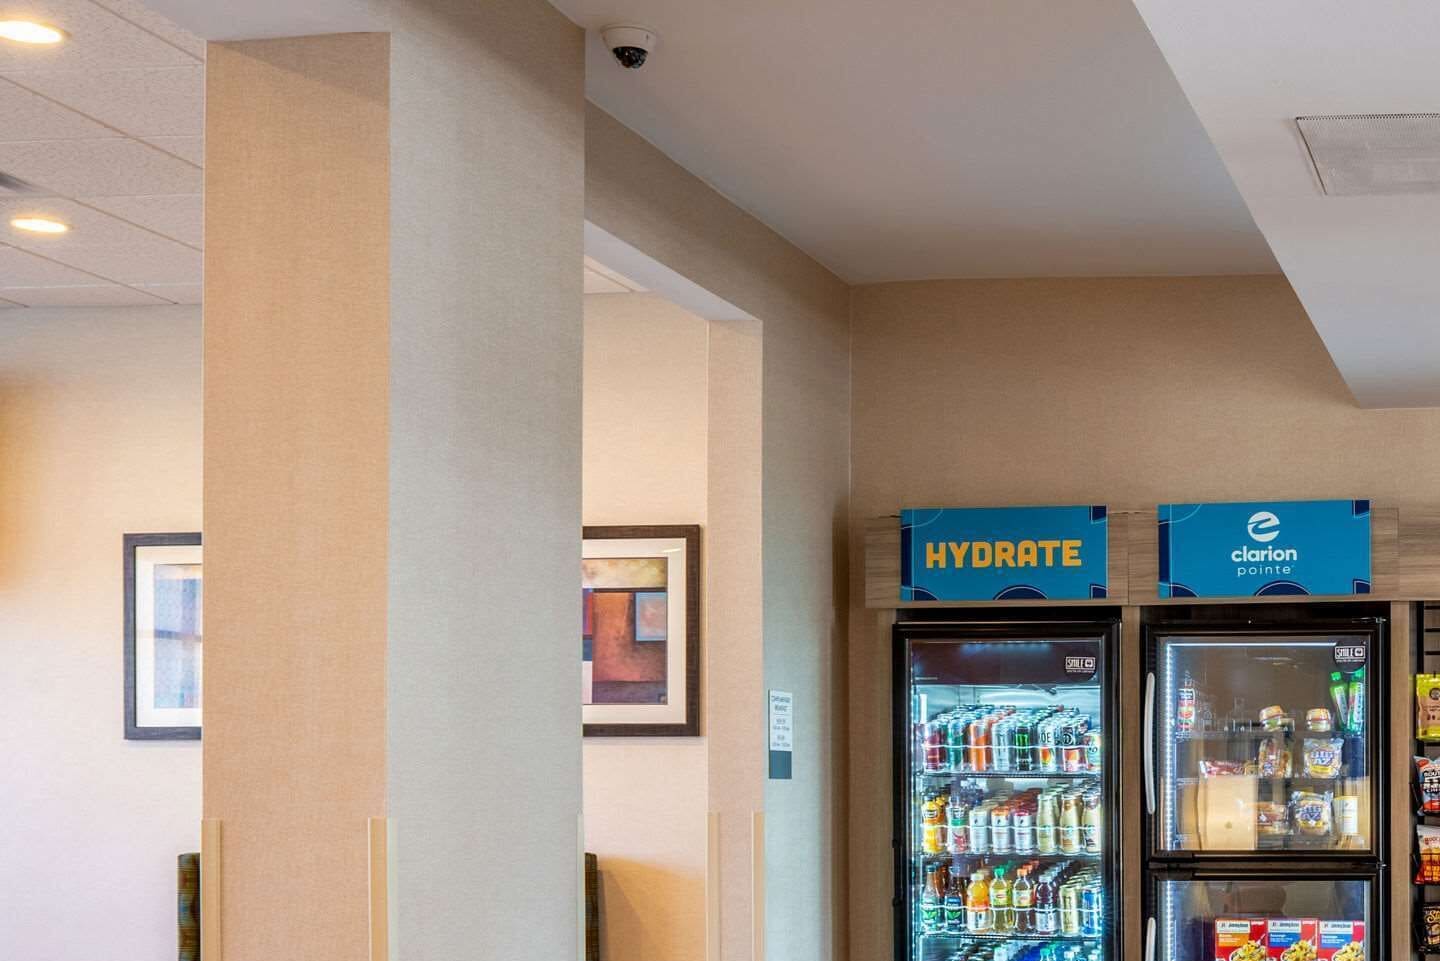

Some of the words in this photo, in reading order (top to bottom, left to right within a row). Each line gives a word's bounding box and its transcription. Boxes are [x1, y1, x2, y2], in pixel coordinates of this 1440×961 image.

[925, 539, 1083, 569] HYDRATE
[1231, 545, 1297, 562] clarion
[1237, 564, 1291, 577] pointe
